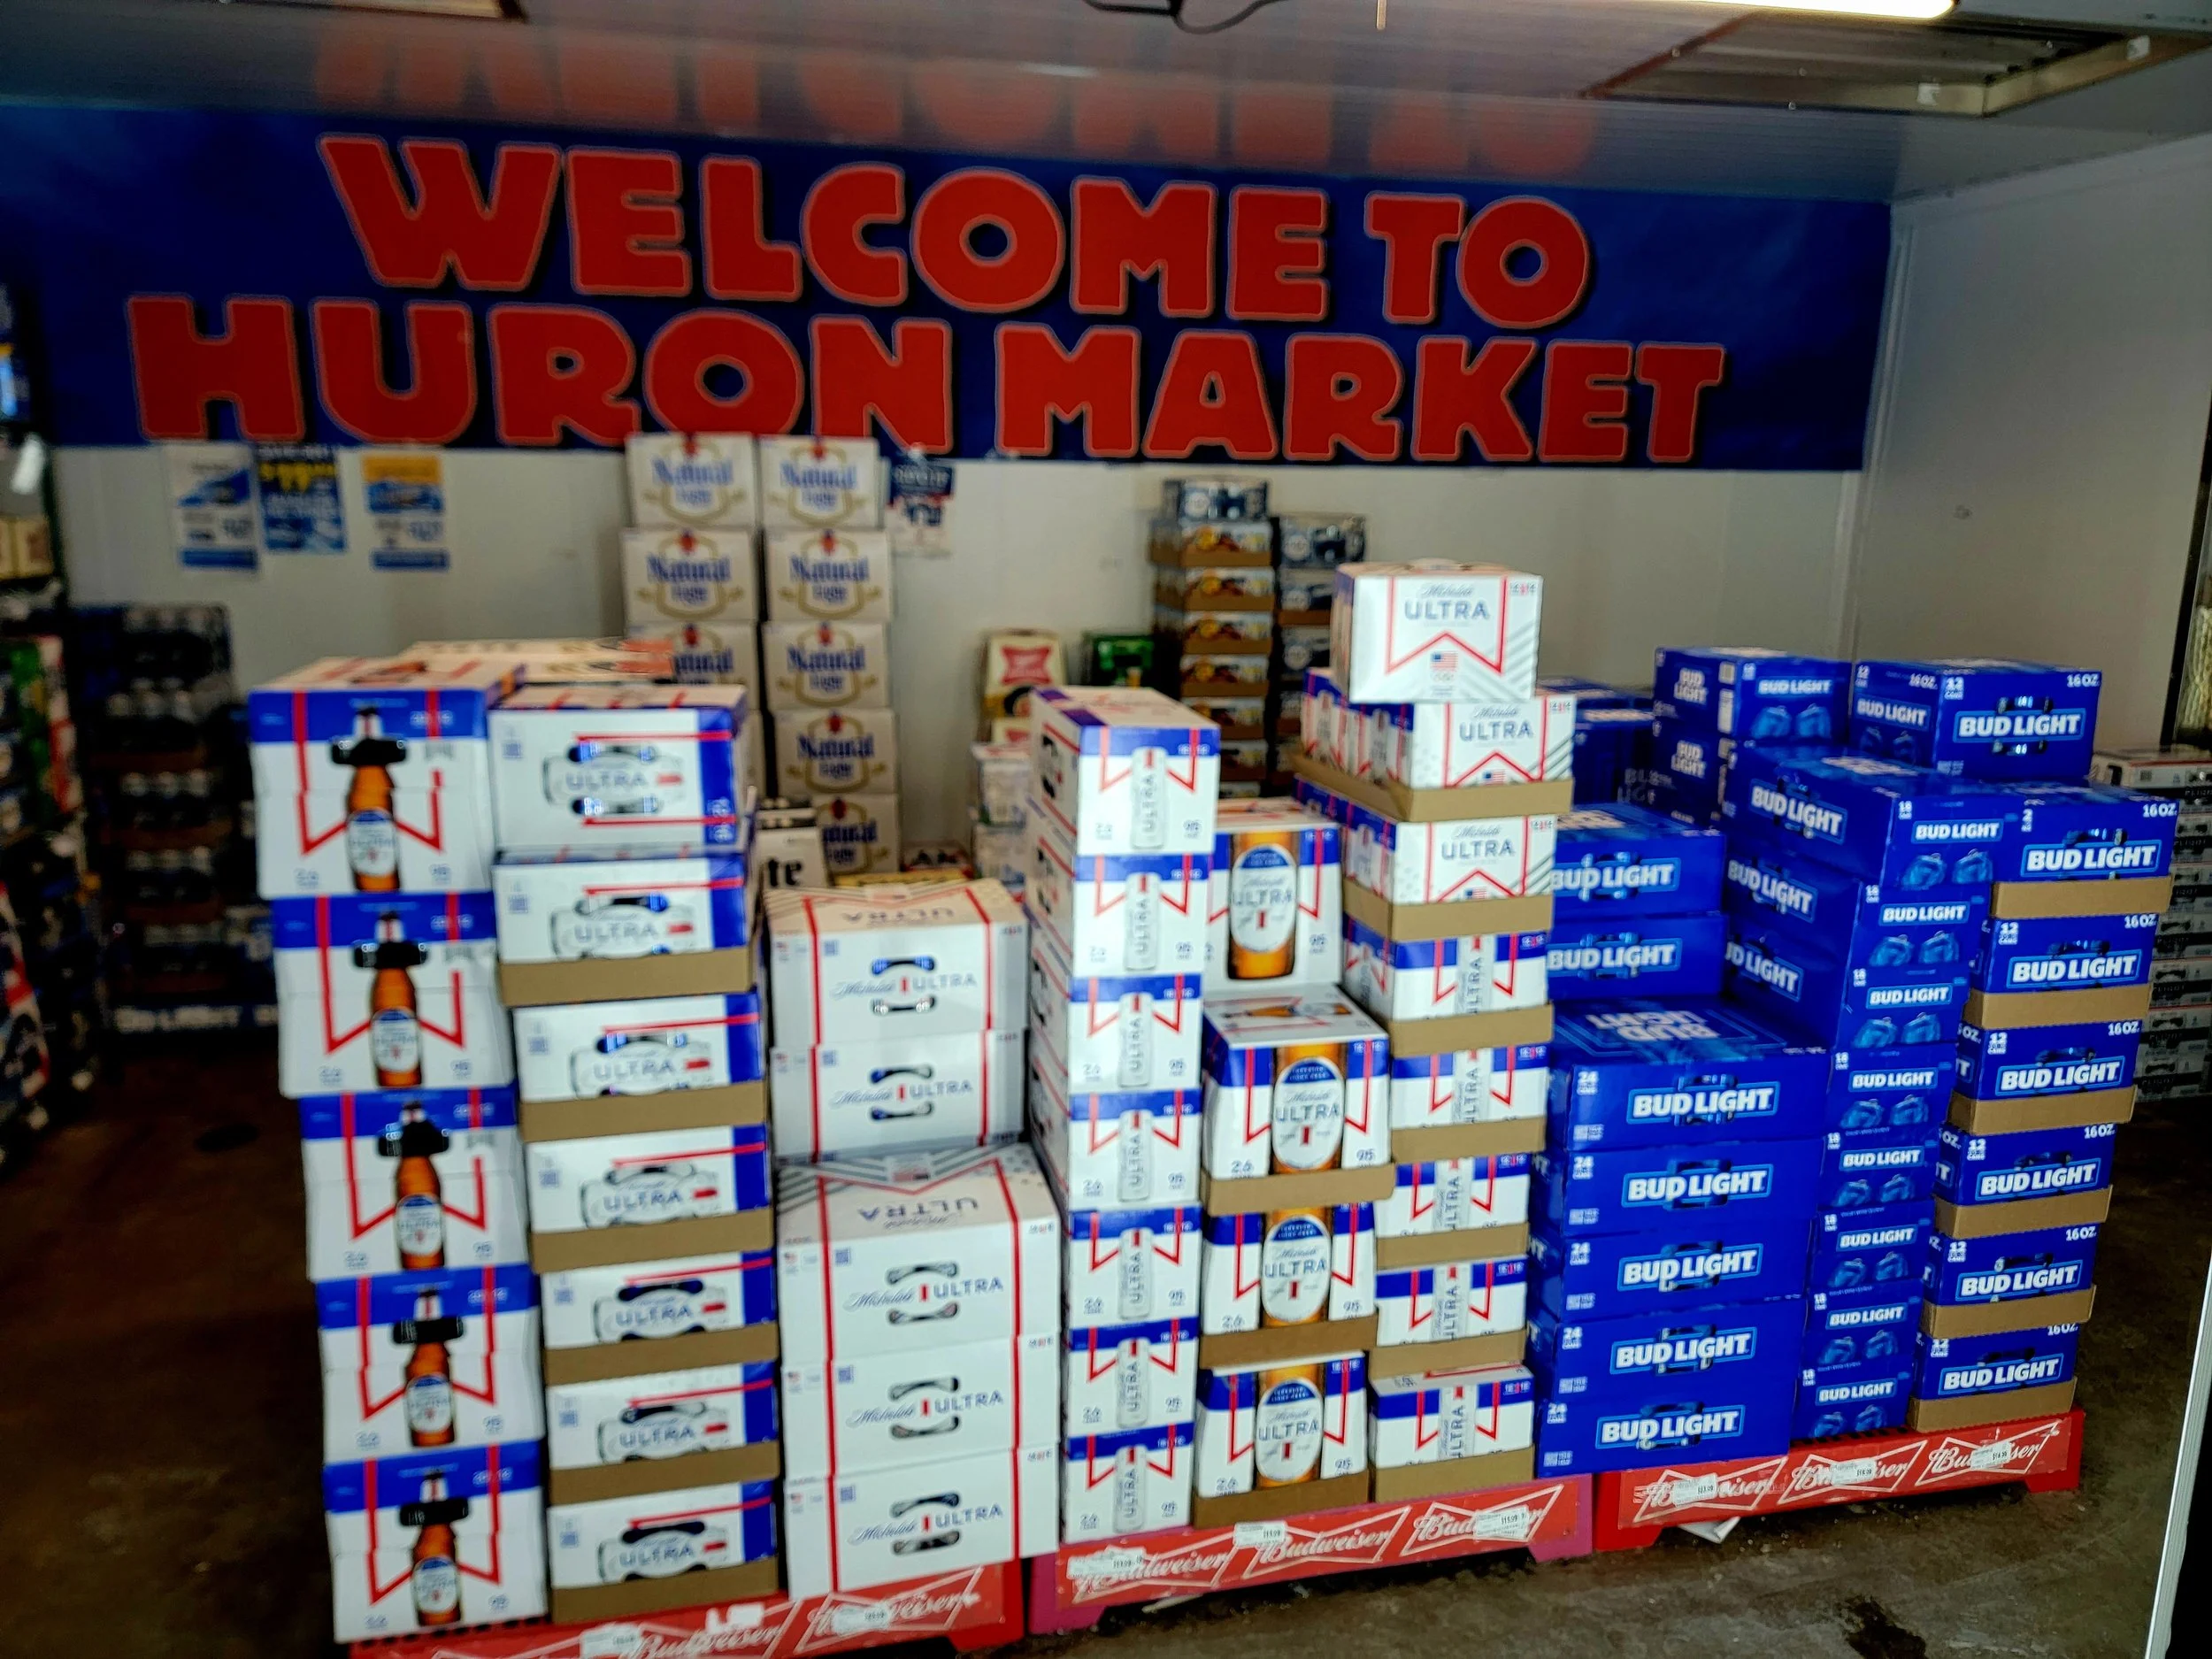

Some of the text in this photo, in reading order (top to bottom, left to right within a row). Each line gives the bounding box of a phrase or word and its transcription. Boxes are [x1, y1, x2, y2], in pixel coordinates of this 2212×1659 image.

[317, 132, 1590, 328] WELCOME TO
[127, 293, 1725, 463] HURON MARKET
[653, 459, 733, 485] Natural
[780, 461, 856, 489] Natural
[647, 554, 731, 582] Natural
[790, 556, 870, 582] Natural
[1404, 600, 1491, 620] ULTRA
[675, 649, 733, 673] atural
[787, 648, 865, 672] Natural
[1679, 667, 1705, 687] BUD
[1758, 679, 1832, 694] BUD LIGHT
[1947, 676, 1964, 690] 12
[2067, 673, 2101, 687] 16 OZ.
[1674, 681, 1709, 704] LIGHT
[1856, 698, 1926, 726] BUD LIGHT
[1459, 720, 1534, 741] ULTRA
[1959, 714, 2081, 737] BUD LIGHT
[798, 734, 873, 758] Natural
[1677, 740, 1703, 761] BUD
[1671, 753, 1707, 779] LIGHT
[1751, 786, 1843, 836] BUD LIGHT
[2143, 803, 2177, 818] 16 OZ.
[822, 822, 877, 844] atural
[1915, 822, 2000, 840] BUD LIGHT
[1441, 839, 1516, 859] ULTRA
[2027, 845, 2157, 871] BUD LIGHT
[1550, 864, 1675, 890] BUD LIGHT
[1727, 860, 1813, 914] BUD LIGHT
[1883, 904, 1966, 922] BUD LIGHT
[2124, 913, 2157, 928] 16 OZ.
[2000, 922, 2019, 934] 12
[1548, 943, 1676, 970] BUD LIGHT
[1745, 948, 1799, 993] LIGHT
[2012, 956, 2138, 982] BUD LIGHT
[912, 974, 978, 991] ULTRA
[1870, 986, 1949, 1006] BUD LIGHT
[2108, 1020, 2140, 1036] 16 OZ.
[1989, 1033, 2008, 1045] 12
[1578, 1071, 1599, 1085] 24
[1852, 1071, 1934, 1089] BUD LIGHT
[2001, 1063, 2120, 1091] BUD LIGHT
[910, 1080, 973, 1099] ULTRA
[1275, 1102, 1340, 1123] ULTRA
[1632, 1087, 1775, 1118] BUD LIGHT
[2084, 1124, 2116, 1139] 16 OZ.
[1969, 1139, 1986, 1150] 12
[1574, 1156, 1594, 1169] 24
[1843, 1149, 1921, 1168] BUD LIGHT
[1628, 1170, 1768, 1201] BUD LIGHT
[1980, 1163, 2096, 1195] BUD LIGHT
[604, 1190, 682, 1210] ULTRA
[1824, 1214, 1838, 1225] 18
[1839, 1227, 1915, 1248] BUD LIGHT
[2066, 1226, 2096, 1240] 16 OZ.
[1571, 1242, 1590, 1256] 24
[1949, 1241, 1967, 1253] 12
[1129, 1251, 1144, 1304] ULTRA
[1264, 1259, 1327, 1279] ULTRA
[1624, 1250, 1757, 1285] BUD LIGHT
[933, 1277, 1003, 1300] ULTRA
[1961, 1265, 2078, 1295] BUD LIGHT
[1814, 1292, 1826, 1305] 18
[616, 1304, 694, 1325] ULTRA
[1223, 1316, 1245, 1328] 2.6
[1830, 1306, 1904, 1327] BUD LIGHT
[1564, 1326, 1583, 1340] 24
[1932, 1339, 1949, 1348] 12
[1616, 1333, 1751, 1368] BUD LIGHT
[1943, 1359, 2059, 1390] BUD LIGHT
[1125, 1361, 1141, 1412] ULTRA
[1818, 1382, 1893, 1402] BUD LIGHT
[934, 1390, 1004, 1414] ULTRA
[1548, 1402, 1567, 1416] 24
[620, 1426, 695, 1447] ULTRA
[1258, 1419, 1319, 1440] ULTRA
[1601, 1410, 1740, 1443] BUD LIGHT
[1124, 1468, 1139, 1517] ULTRA
[1216, 1478, 1239, 1490] 2.6
[935, 1504, 1003, 1528] ULTRA
[1256, 1528, 1394, 1563] Budweiser
[619, 1548, 694, 1567] ULTRA
